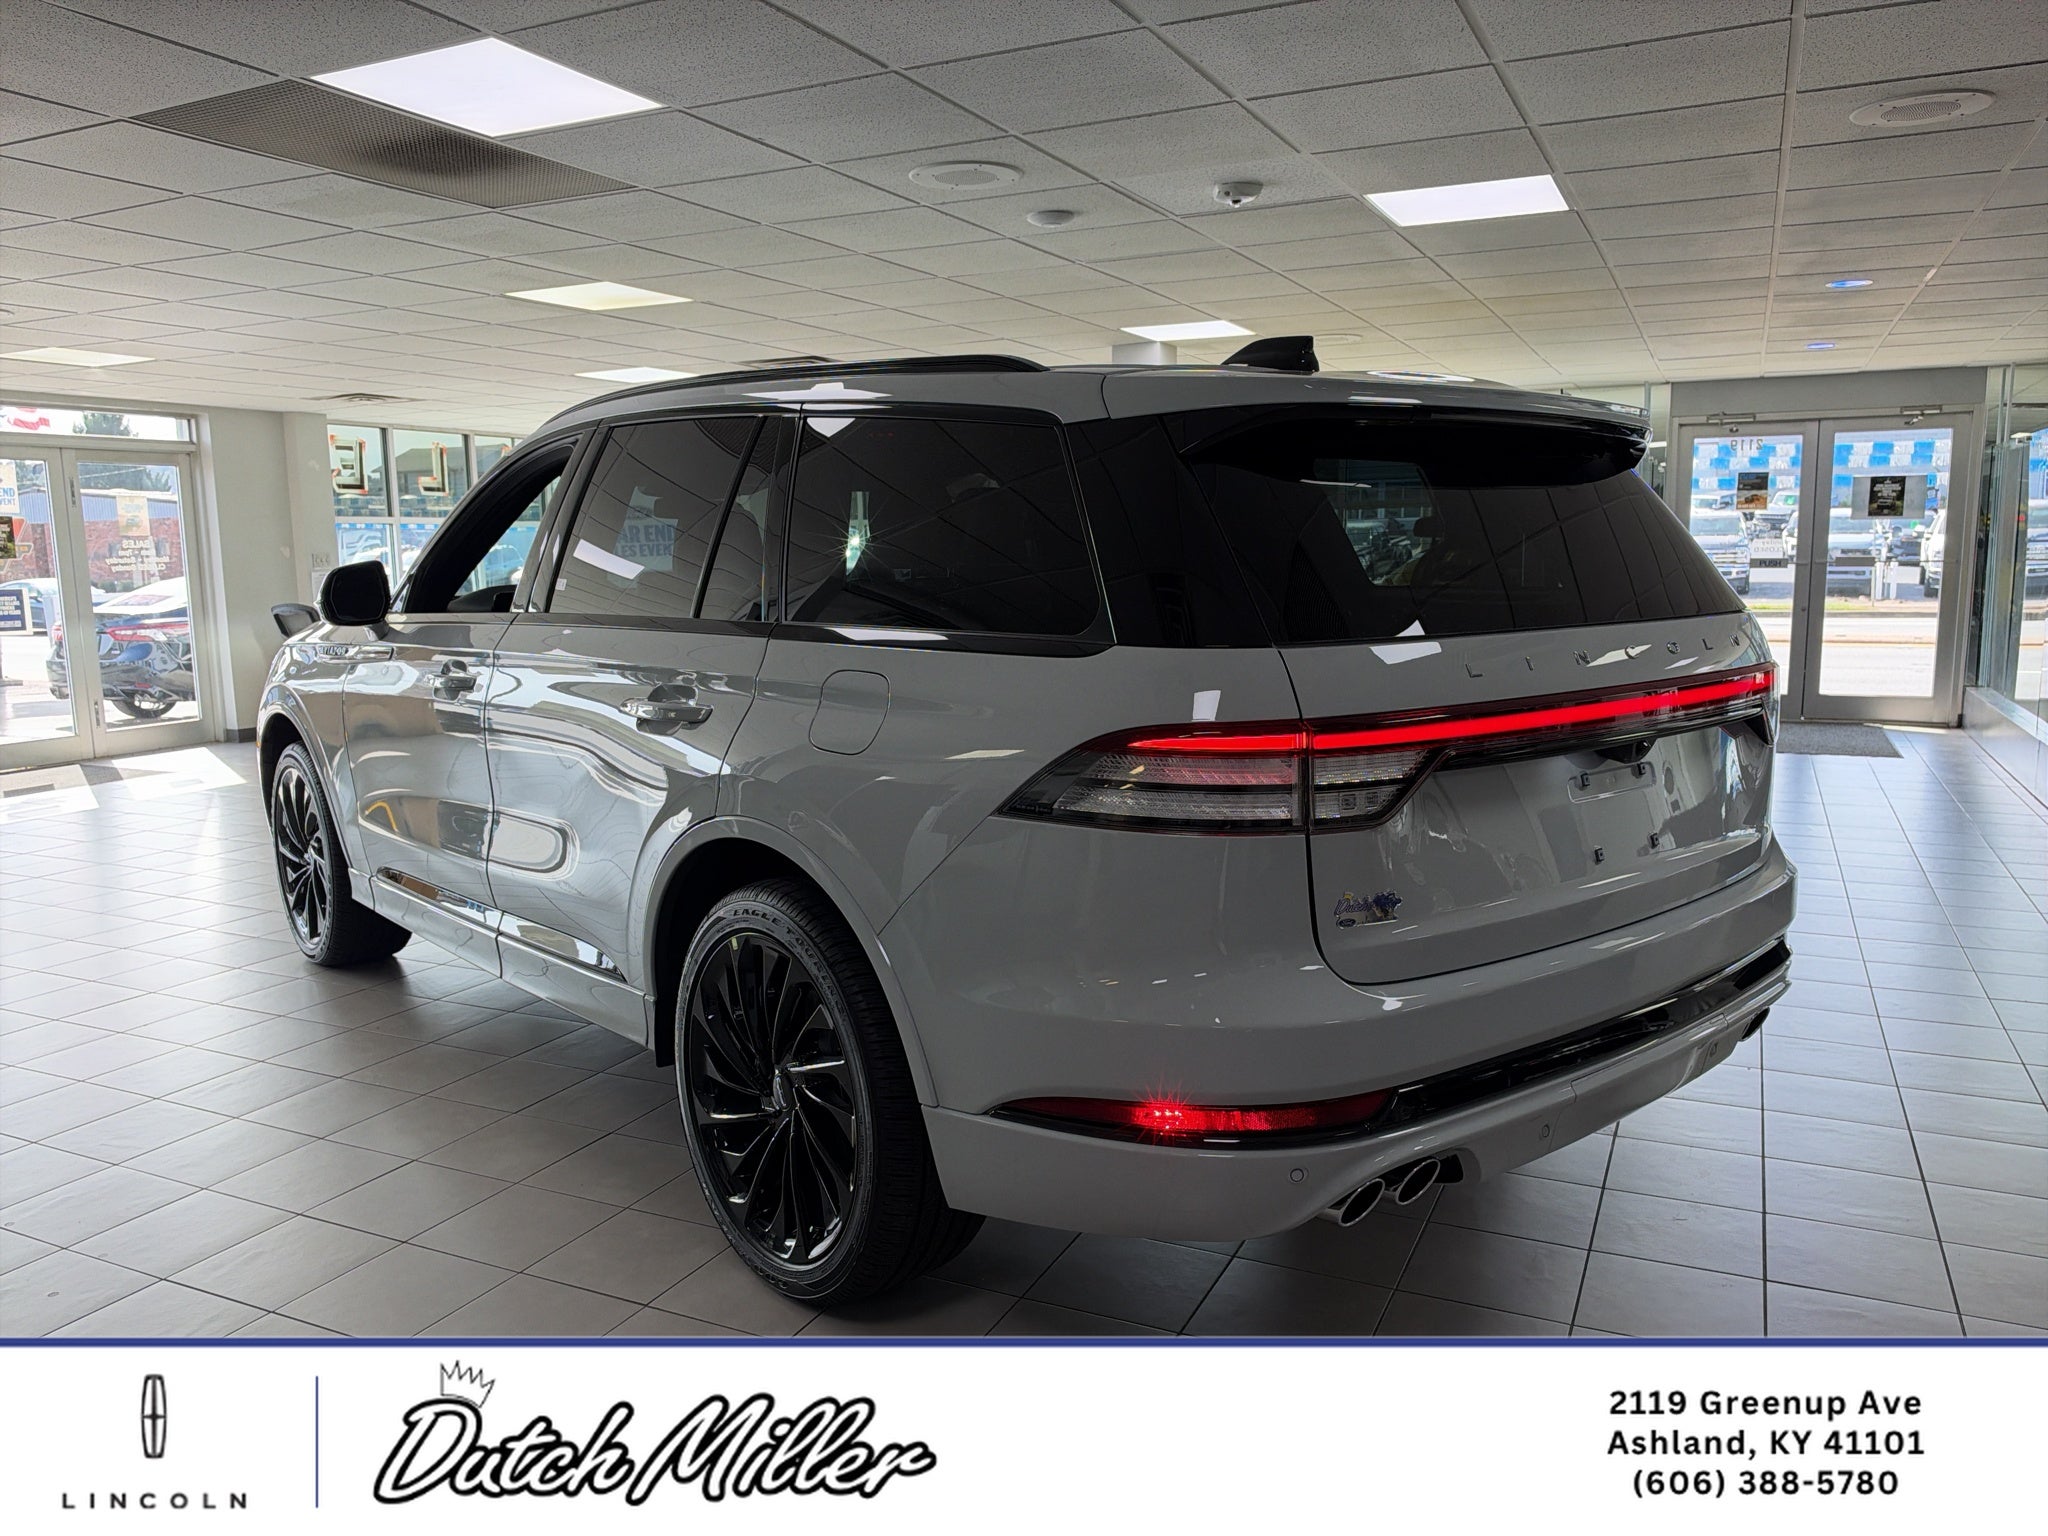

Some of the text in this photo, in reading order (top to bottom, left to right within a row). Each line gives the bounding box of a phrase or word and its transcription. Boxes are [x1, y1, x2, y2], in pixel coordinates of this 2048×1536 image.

[1759, 559, 1781, 568] PUSH
[1465, 634, 1741, 678] LINCOLN
[732, 908, 784, 926] EAGLE
